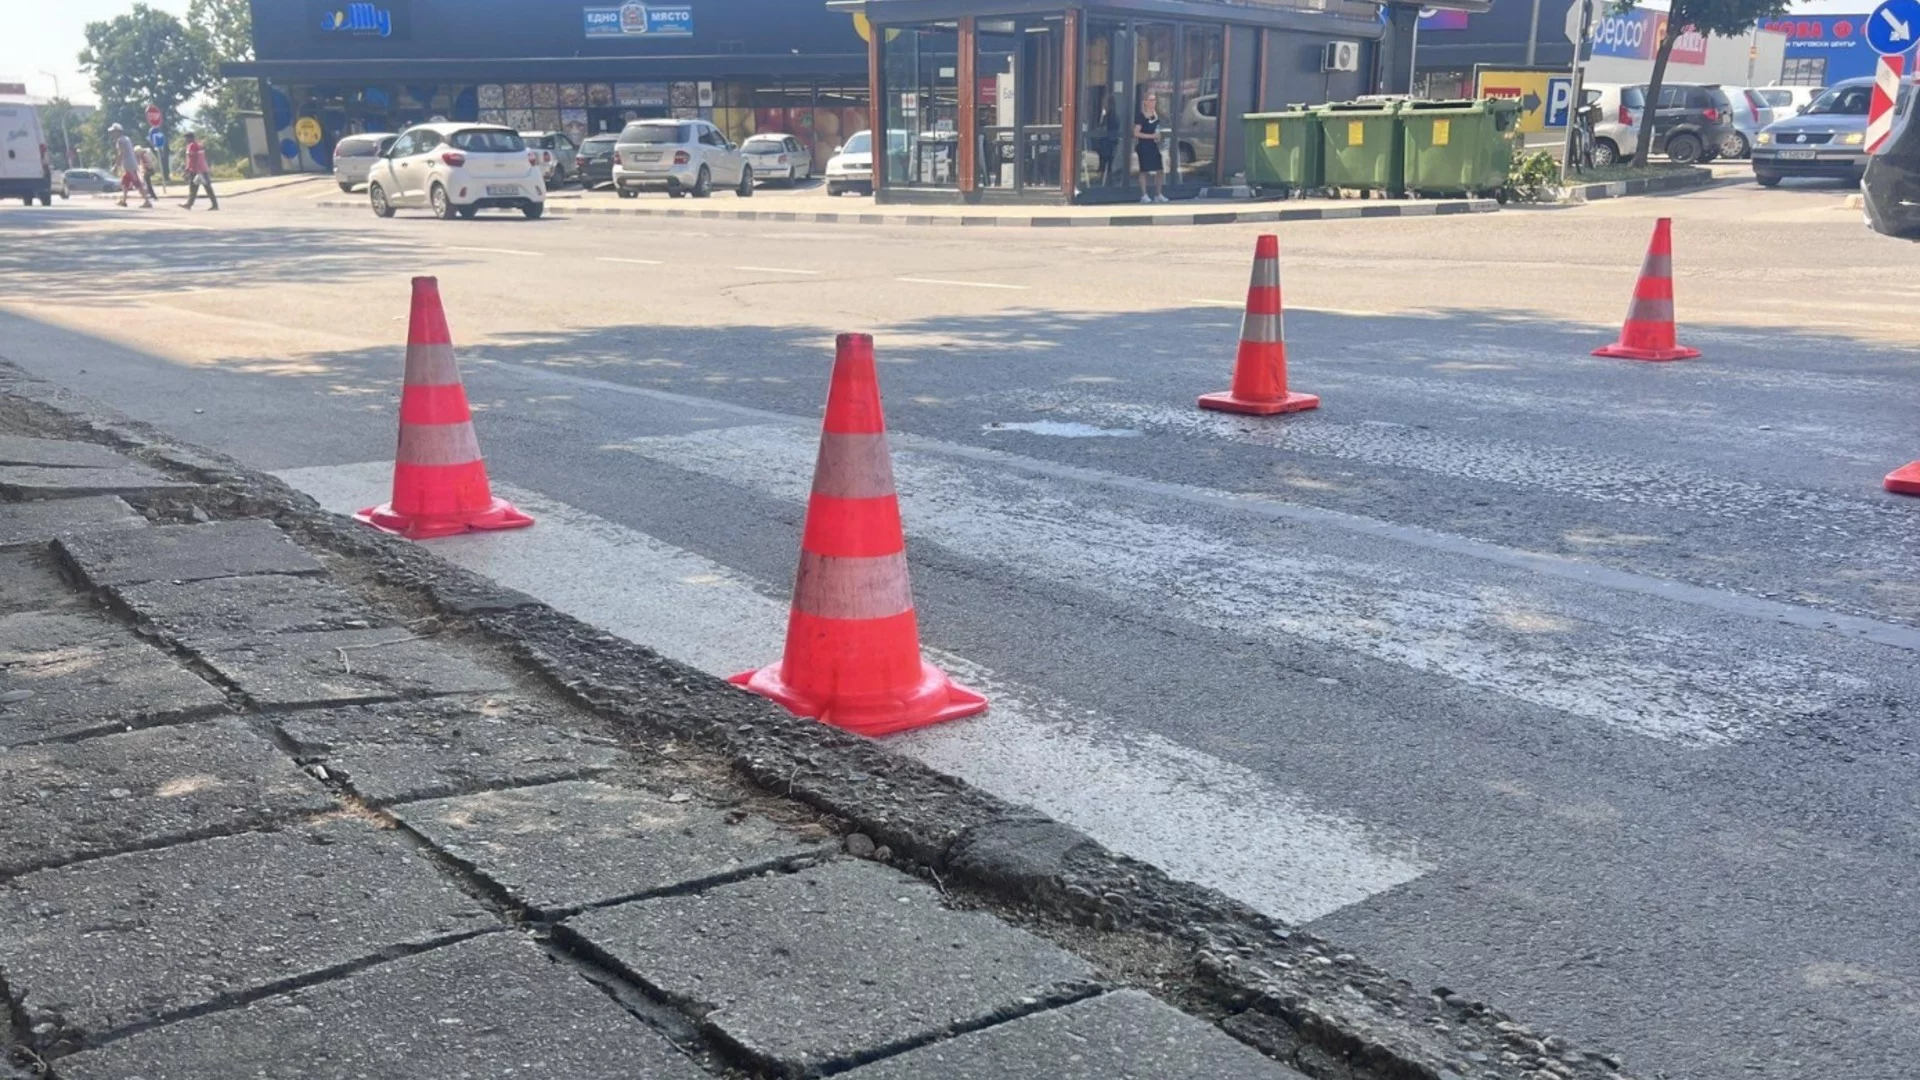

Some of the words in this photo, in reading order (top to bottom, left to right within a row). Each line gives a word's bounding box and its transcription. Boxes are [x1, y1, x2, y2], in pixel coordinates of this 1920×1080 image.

[587, 13, 618, 23] ЕДНО
[651, 12, 690, 21] МЯСТО
[1592, 17, 1643, 52] pepco
[1549, 81, 1572, 124] P
